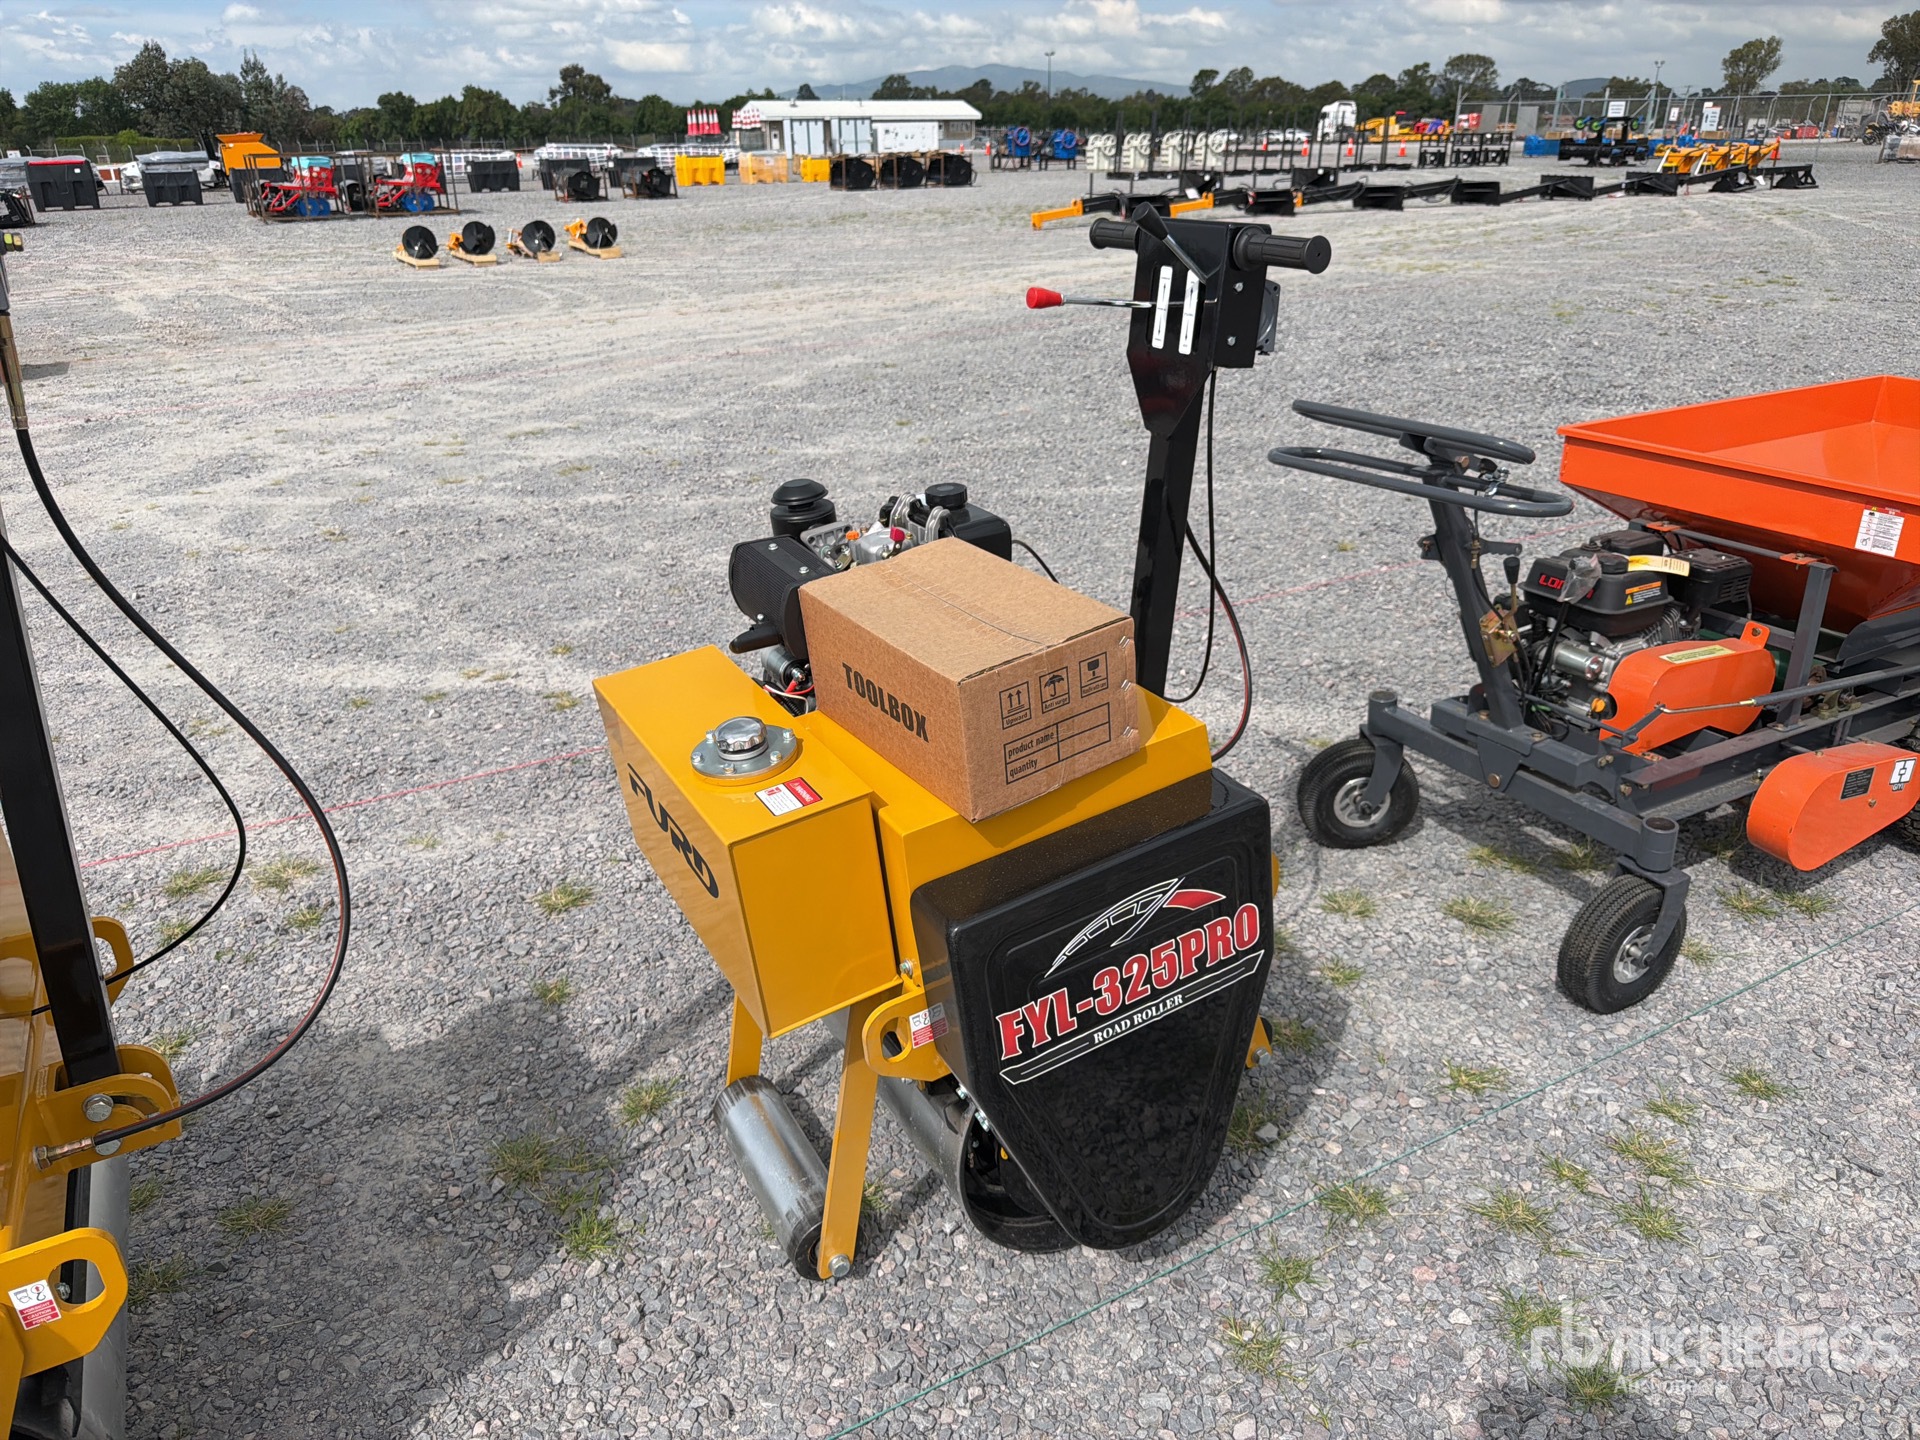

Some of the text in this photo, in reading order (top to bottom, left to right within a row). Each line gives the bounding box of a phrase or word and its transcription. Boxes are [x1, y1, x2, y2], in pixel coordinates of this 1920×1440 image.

[842, 661, 929, 744] TOOLBOX
[1005, 712, 1028, 725] Upward
[1008, 731, 1055, 759] product name
[1009, 759, 1038, 779] quantity
[627, 762, 719, 899] FURD
[996, 903, 1260, 1060] FYL-325PRO
[1093, 994, 1184, 1044] ROAD ROLLER
[26, 1308, 52, 1320] CAUTION
